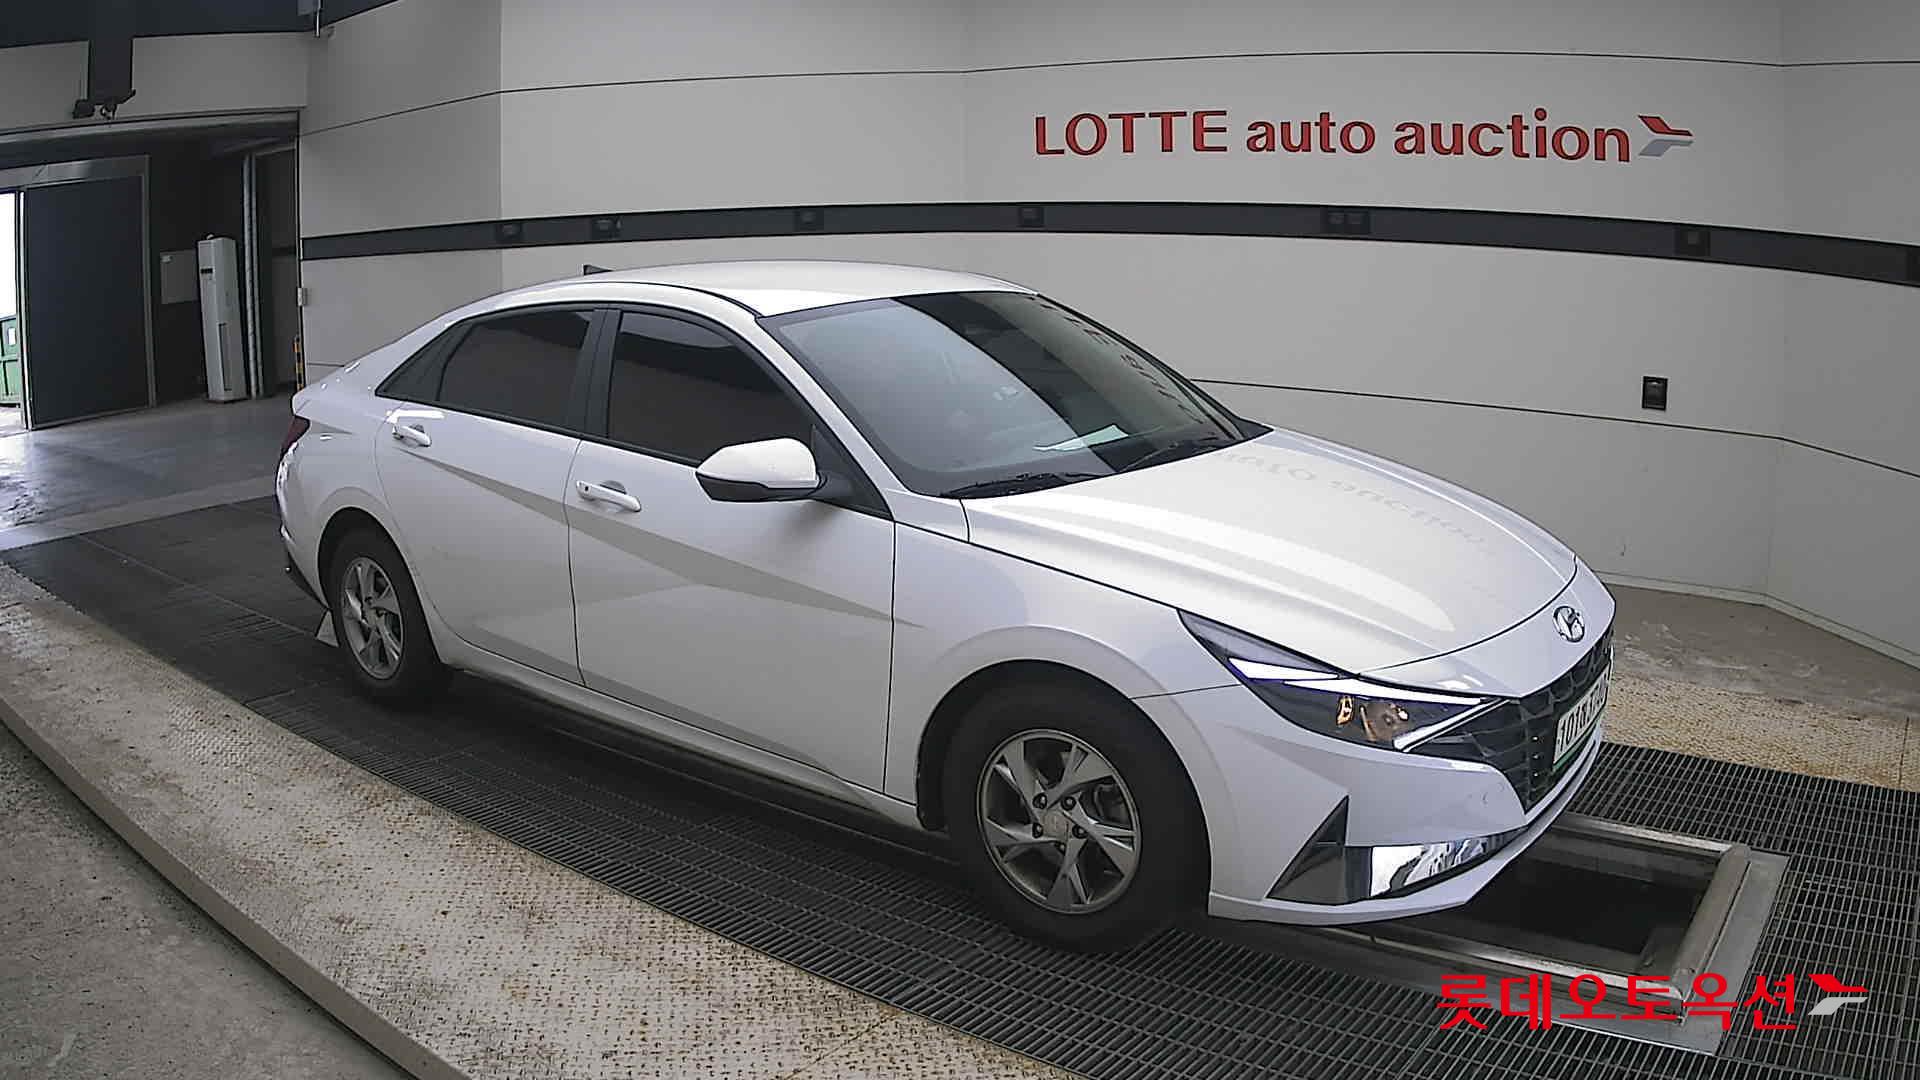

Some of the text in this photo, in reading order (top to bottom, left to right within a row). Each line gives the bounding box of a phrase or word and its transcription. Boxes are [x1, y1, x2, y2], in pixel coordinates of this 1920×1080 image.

[1034, 108, 1632, 163] LOTTE auto auction
